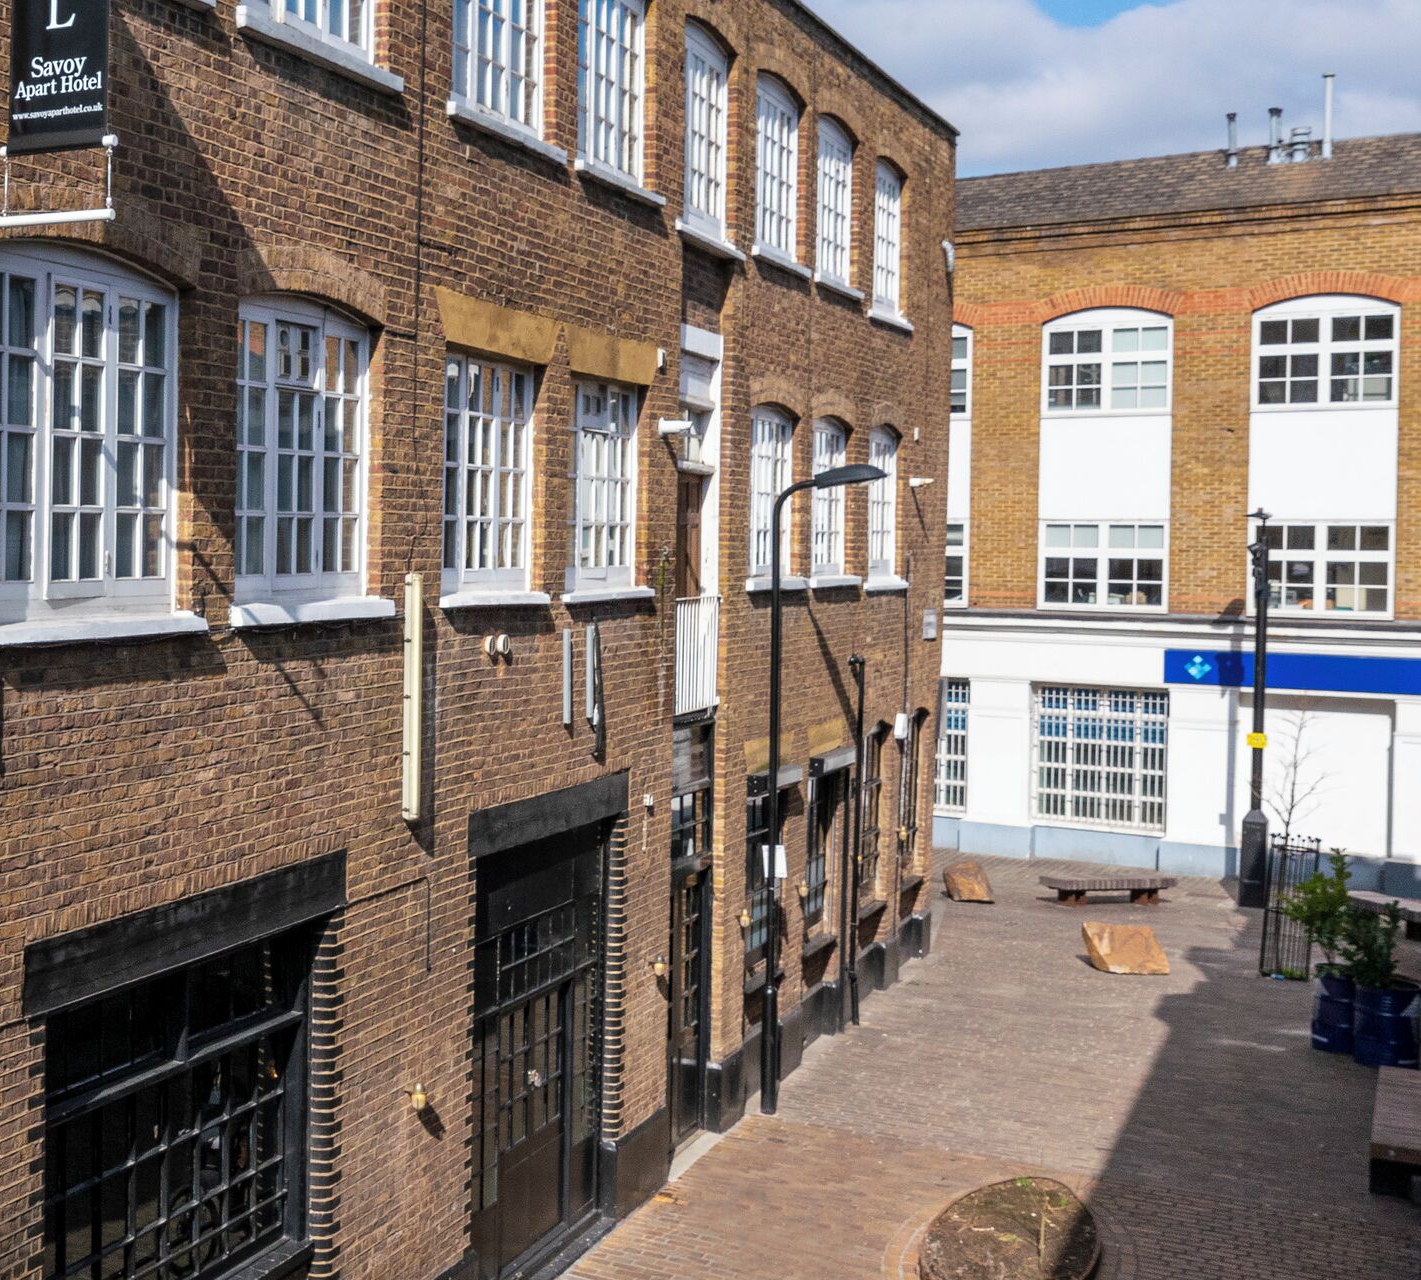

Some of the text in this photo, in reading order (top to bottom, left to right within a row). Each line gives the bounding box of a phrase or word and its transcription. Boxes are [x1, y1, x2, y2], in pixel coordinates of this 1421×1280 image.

[31, 56, 87, 78] Savoy
[14, 71, 102, 101] Apart Hotel
[12, 102, 103, 120] www.savoyaparthotel.co.uk
